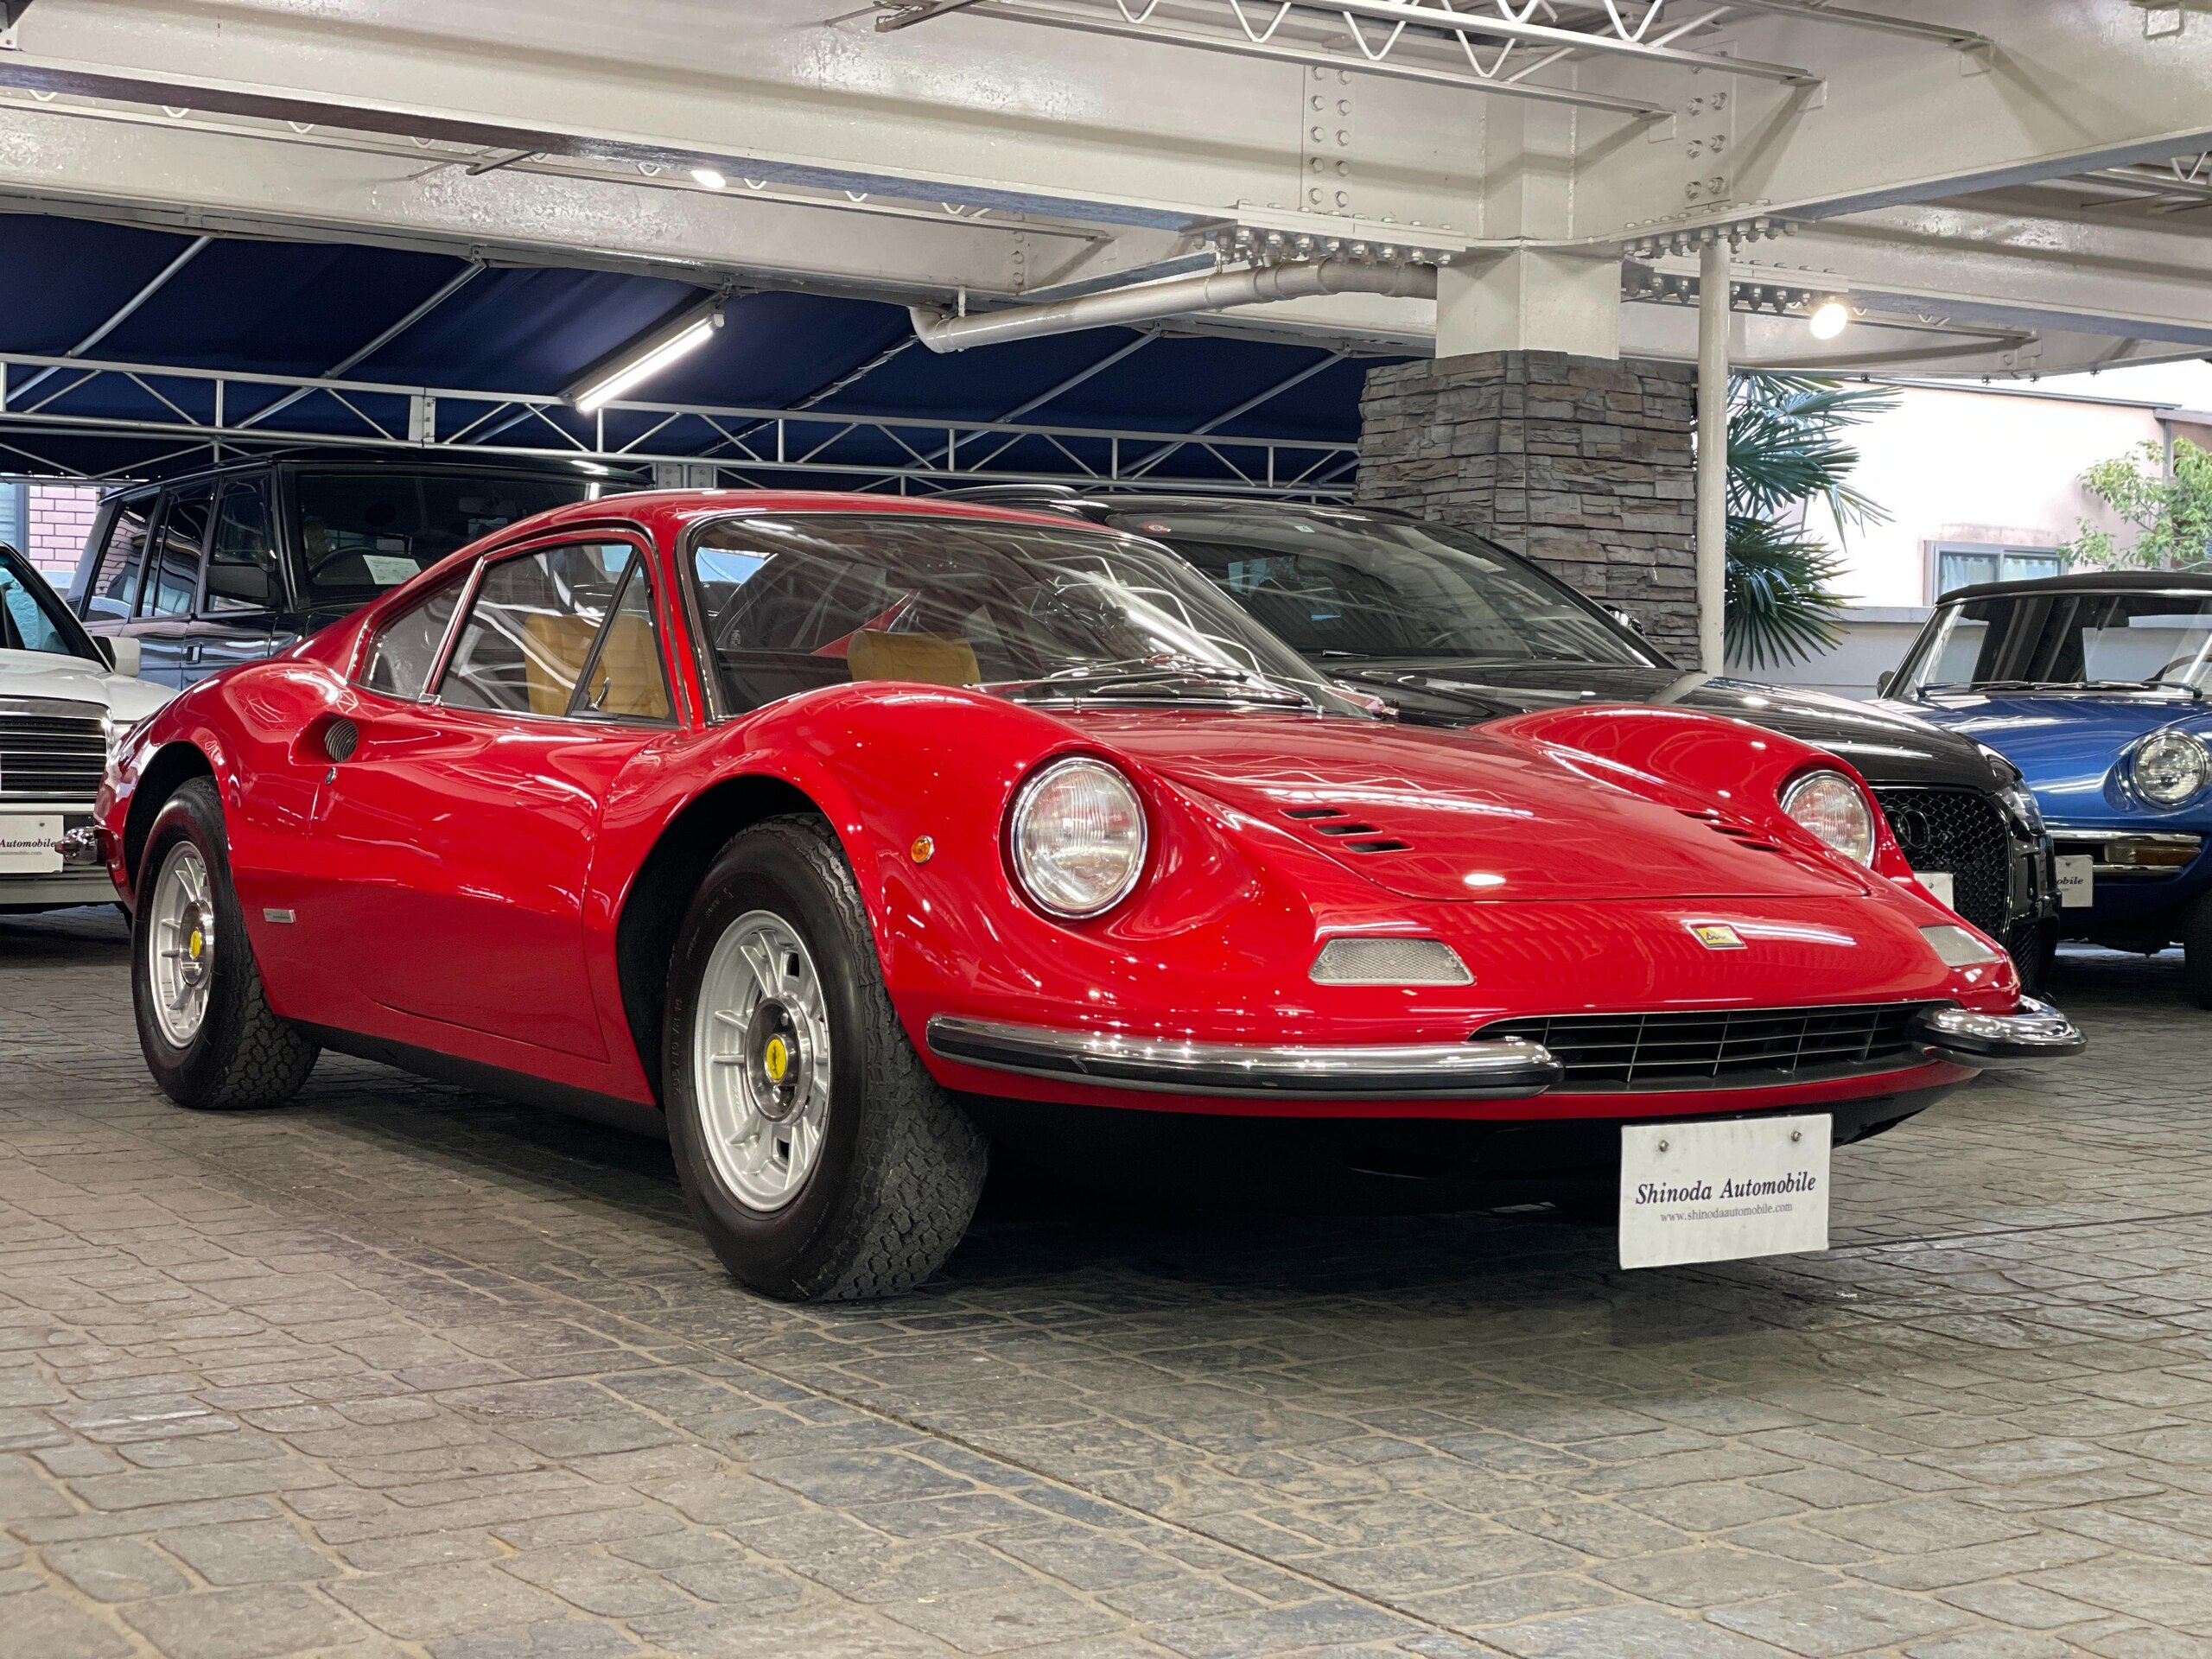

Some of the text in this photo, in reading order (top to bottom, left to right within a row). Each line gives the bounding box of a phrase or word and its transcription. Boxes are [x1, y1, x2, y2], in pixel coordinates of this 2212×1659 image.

[0, 838, 56, 848] Automobile
[1636, 1171, 1815, 1204] Shinoda Automobile
[1660, 1203, 1793, 1222] www.shinodaautomobile.com
